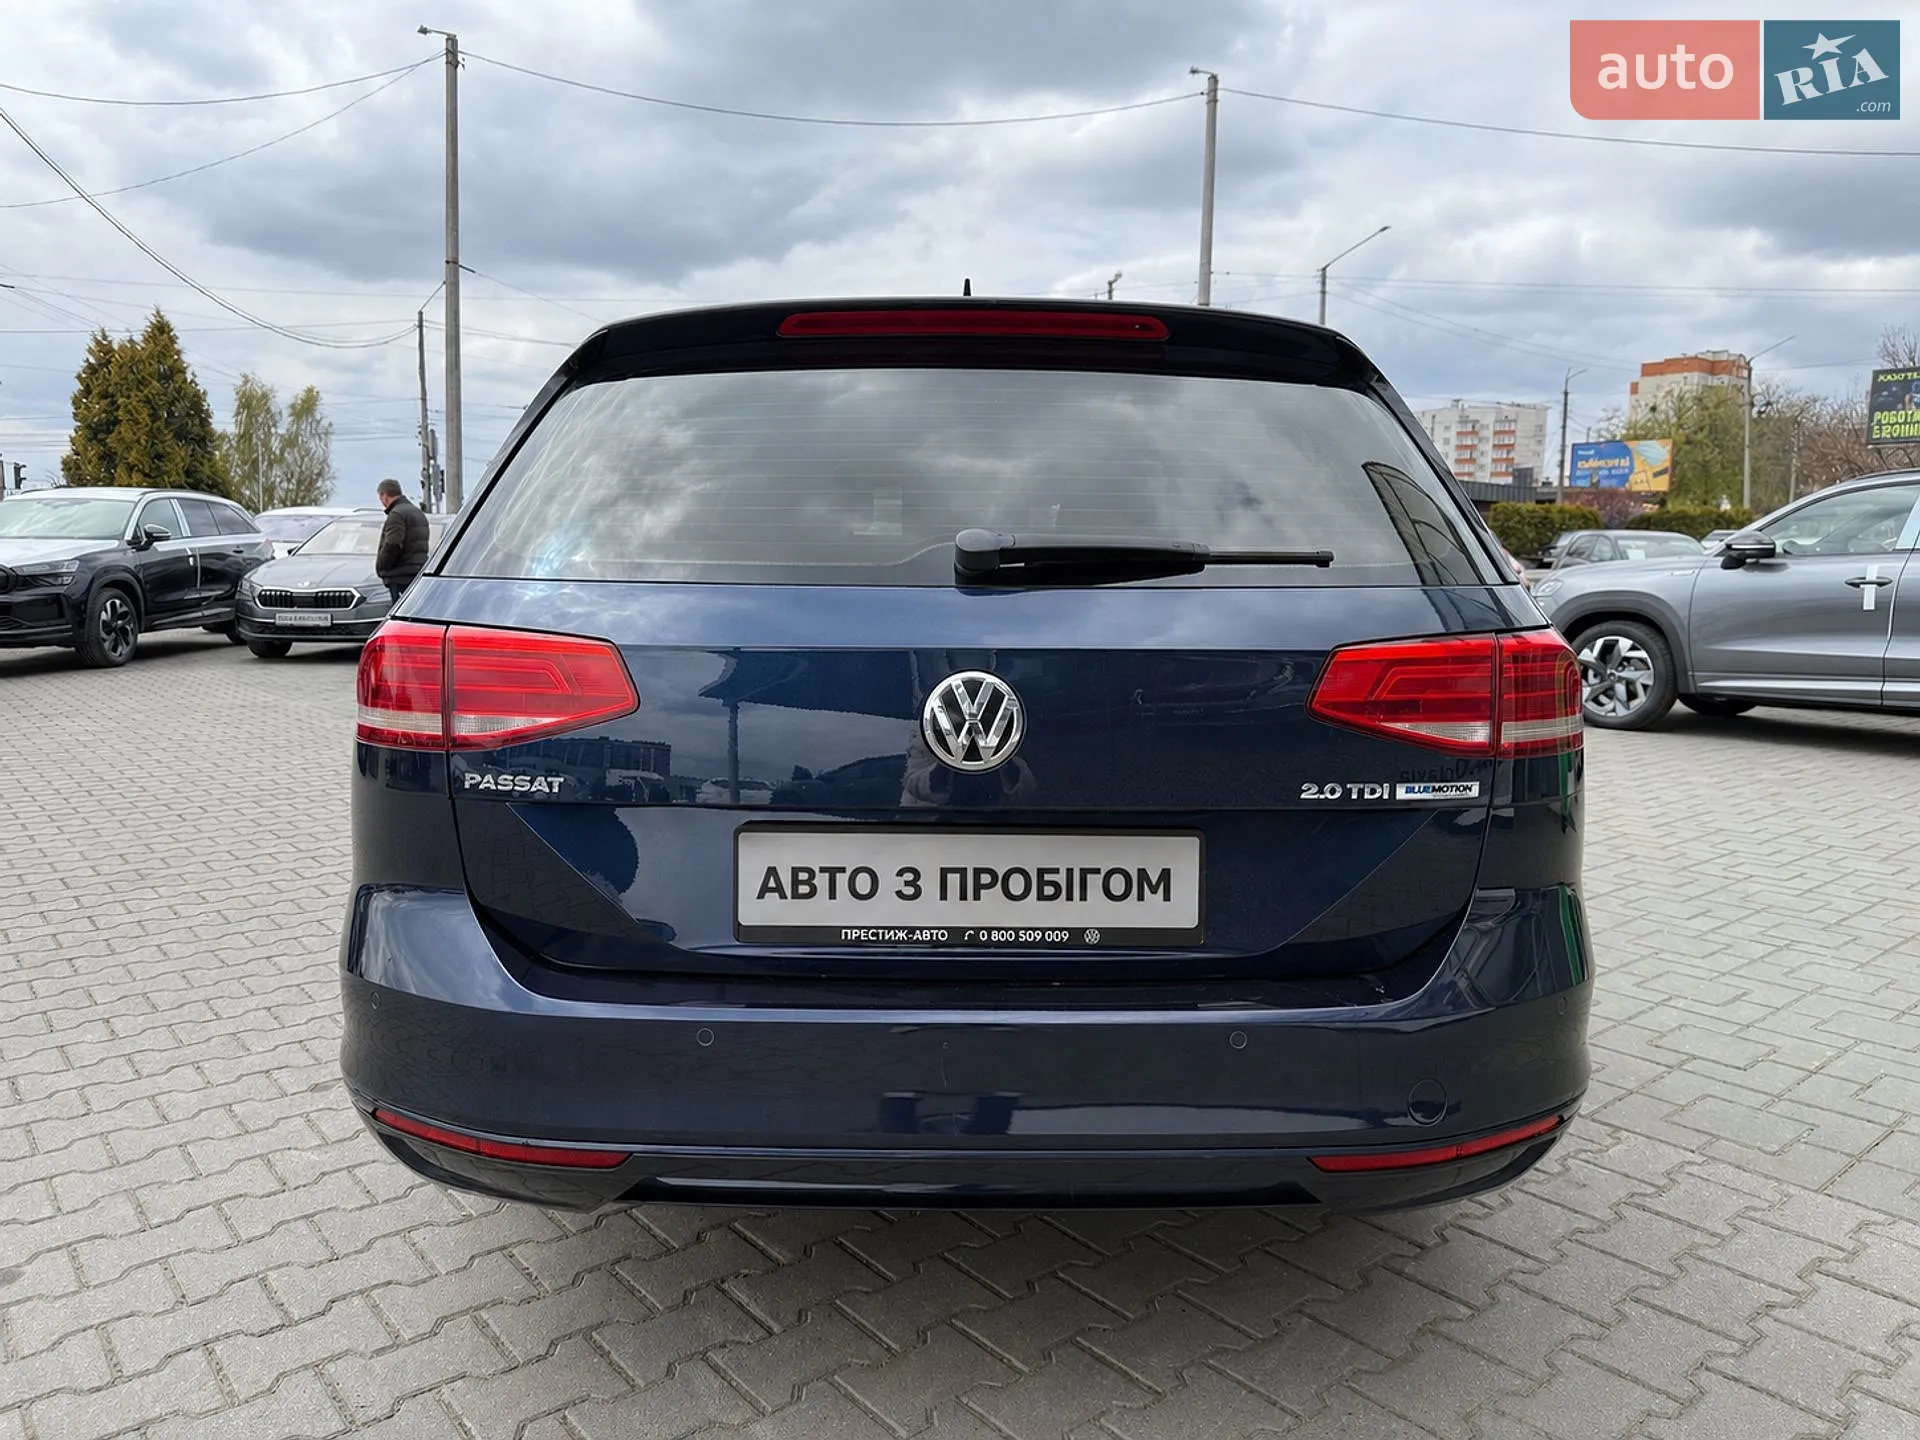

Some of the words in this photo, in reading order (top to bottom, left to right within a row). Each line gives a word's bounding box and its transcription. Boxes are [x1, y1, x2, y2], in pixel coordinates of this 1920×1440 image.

[463, 772, 565, 793] PASSAT
[1300, 783, 1343, 800] 2.0
[1346, 783, 1390, 800] TDI
[756, 865, 880, 901] АВТО
[939, 866, 1172, 903] ПРОБІГОМ
[841, 929, 948, 942] ПРЕСТИЖ-АВТО
[979, 930, 988, 942] 0
[991, 930, 1016, 942] 800
[1018, 930, 1042, 942] 509
[1044, 930, 1069, 942] 009
